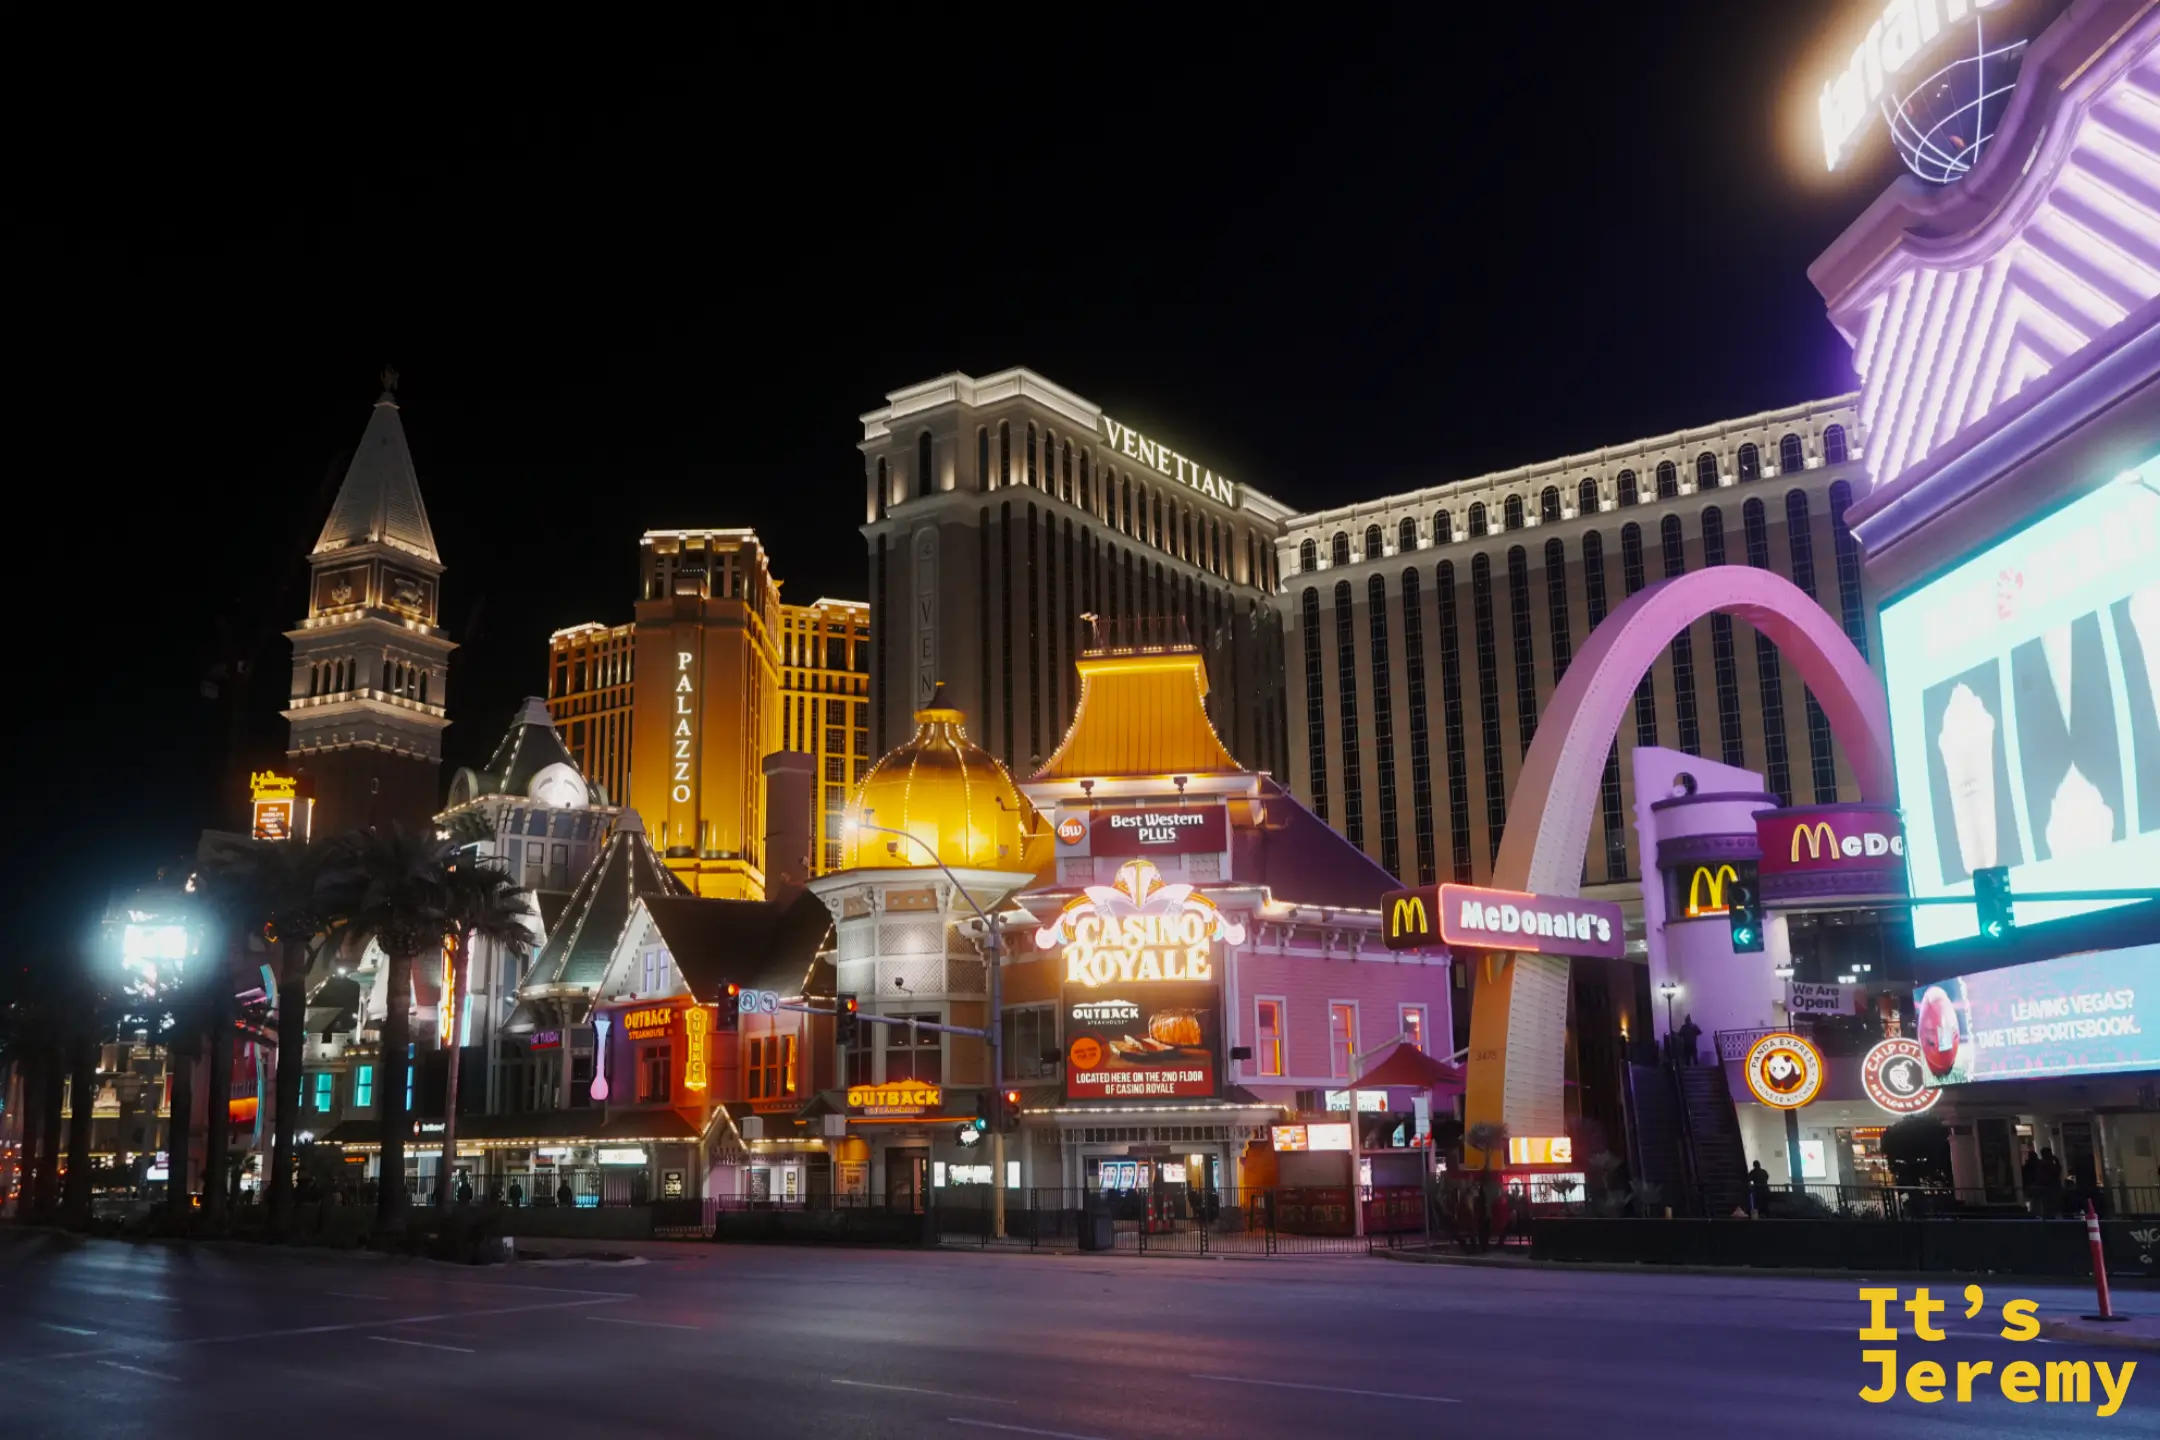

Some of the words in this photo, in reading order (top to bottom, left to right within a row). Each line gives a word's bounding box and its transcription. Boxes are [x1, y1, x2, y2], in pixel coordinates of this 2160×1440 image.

[1102, 415, 1234, 507] VENETIAN
[672, 652, 693, 803] PALAZZO
[1062, 825, 1082, 837] BW
[1111, 814, 1142, 828] Best
[1146, 813, 1204, 826] Western
[1139, 828, 1176, 841] PLUS
[1460, 900, 1611, 942] McDonald's
[1075, 914, 1205, 951] CASINO
[1062, 939, 1211, 987] ROYALE
[1792, 983, 1813, 995] We
[1816, 985, 1839, 996] Are
[1072, 1008, 1139, 1019] OUTBACK
[1792, 995, 1839, 1011] Open!
[2012, 997, 2069, 1022] LEAVING
[2070, 989, 2135, 1014] VEGAS?
[624, 1008, 671, 1030] OUTBACK
[1977, 1030, 2005, 1048] TAKE
[2005, 1025, 2029, 1046] THE
[2029, 1014, 2141, 1044] SPORTSBOOK.
[1752, 1041, 1776, 1068] PANDA
[1779, 1039, 1816, 1068] EXPRESS
[1867, 1043, 1920, 1072] CHIPOT
[1076, 1073, 1110, 1083] LOCATED
[1111, 1072, 1131, 1082] HERE
[1133, 1072, 1144, 1082] ON
[1146, 1072, 1160, 1082] THE
[1162, 1071, 1177, 1082] 2ND
[1180, 1071, 1203, 1082] FLOOR
[848, 1090, 939, 1107] OUTBACK
[1105, 1083, 1115, 1094] OF
[1116, 1084, 1144, 1094] CASINO
[1146, 1083, 1174, 1094] ROYALE
[1755, 1080, 1784, 1102] CHINESE
